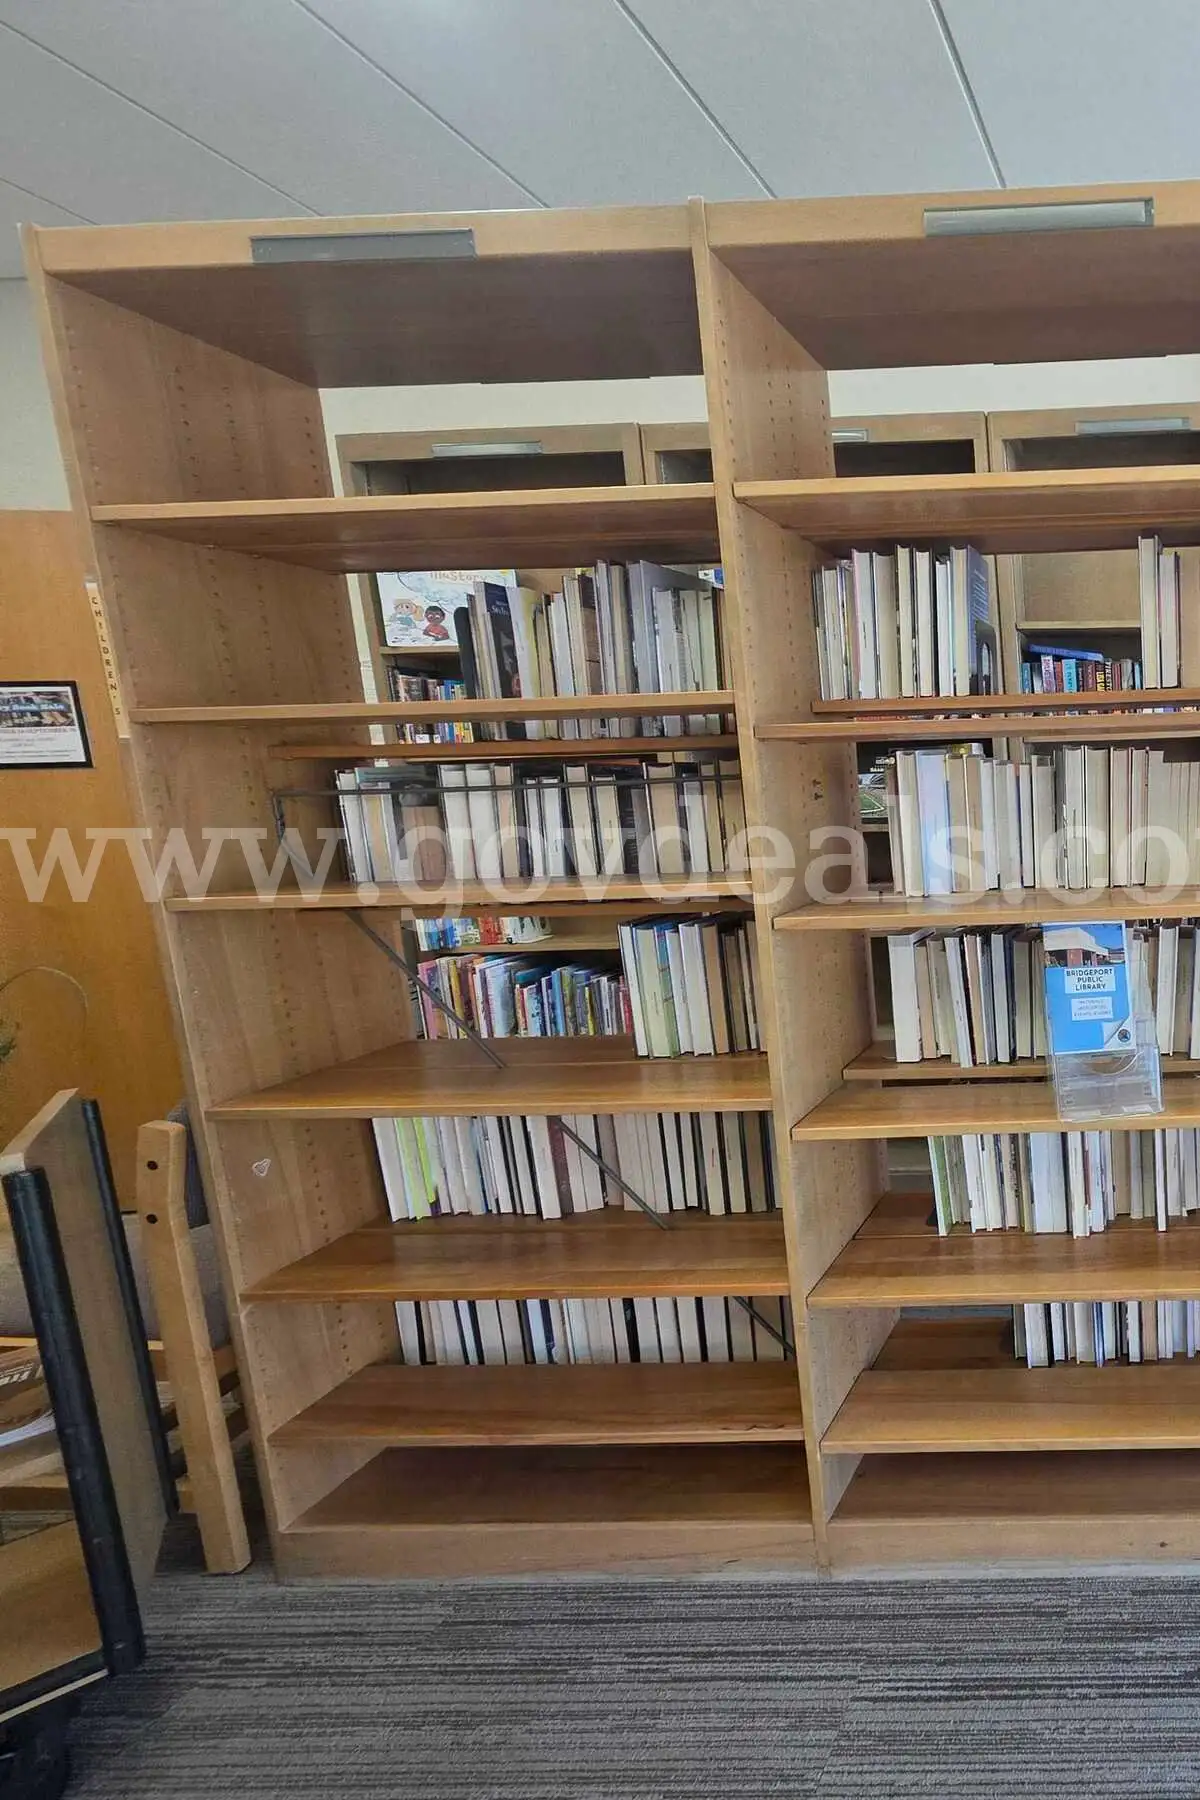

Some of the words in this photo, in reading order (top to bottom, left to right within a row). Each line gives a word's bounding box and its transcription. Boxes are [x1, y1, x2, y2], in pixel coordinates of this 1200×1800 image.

[91, 596, 121, 715] CHILDREN'S
[1066, 968, 1113, 976] BRIDGEPORT
[1075, 983, 1106, 991] LIBRARY
